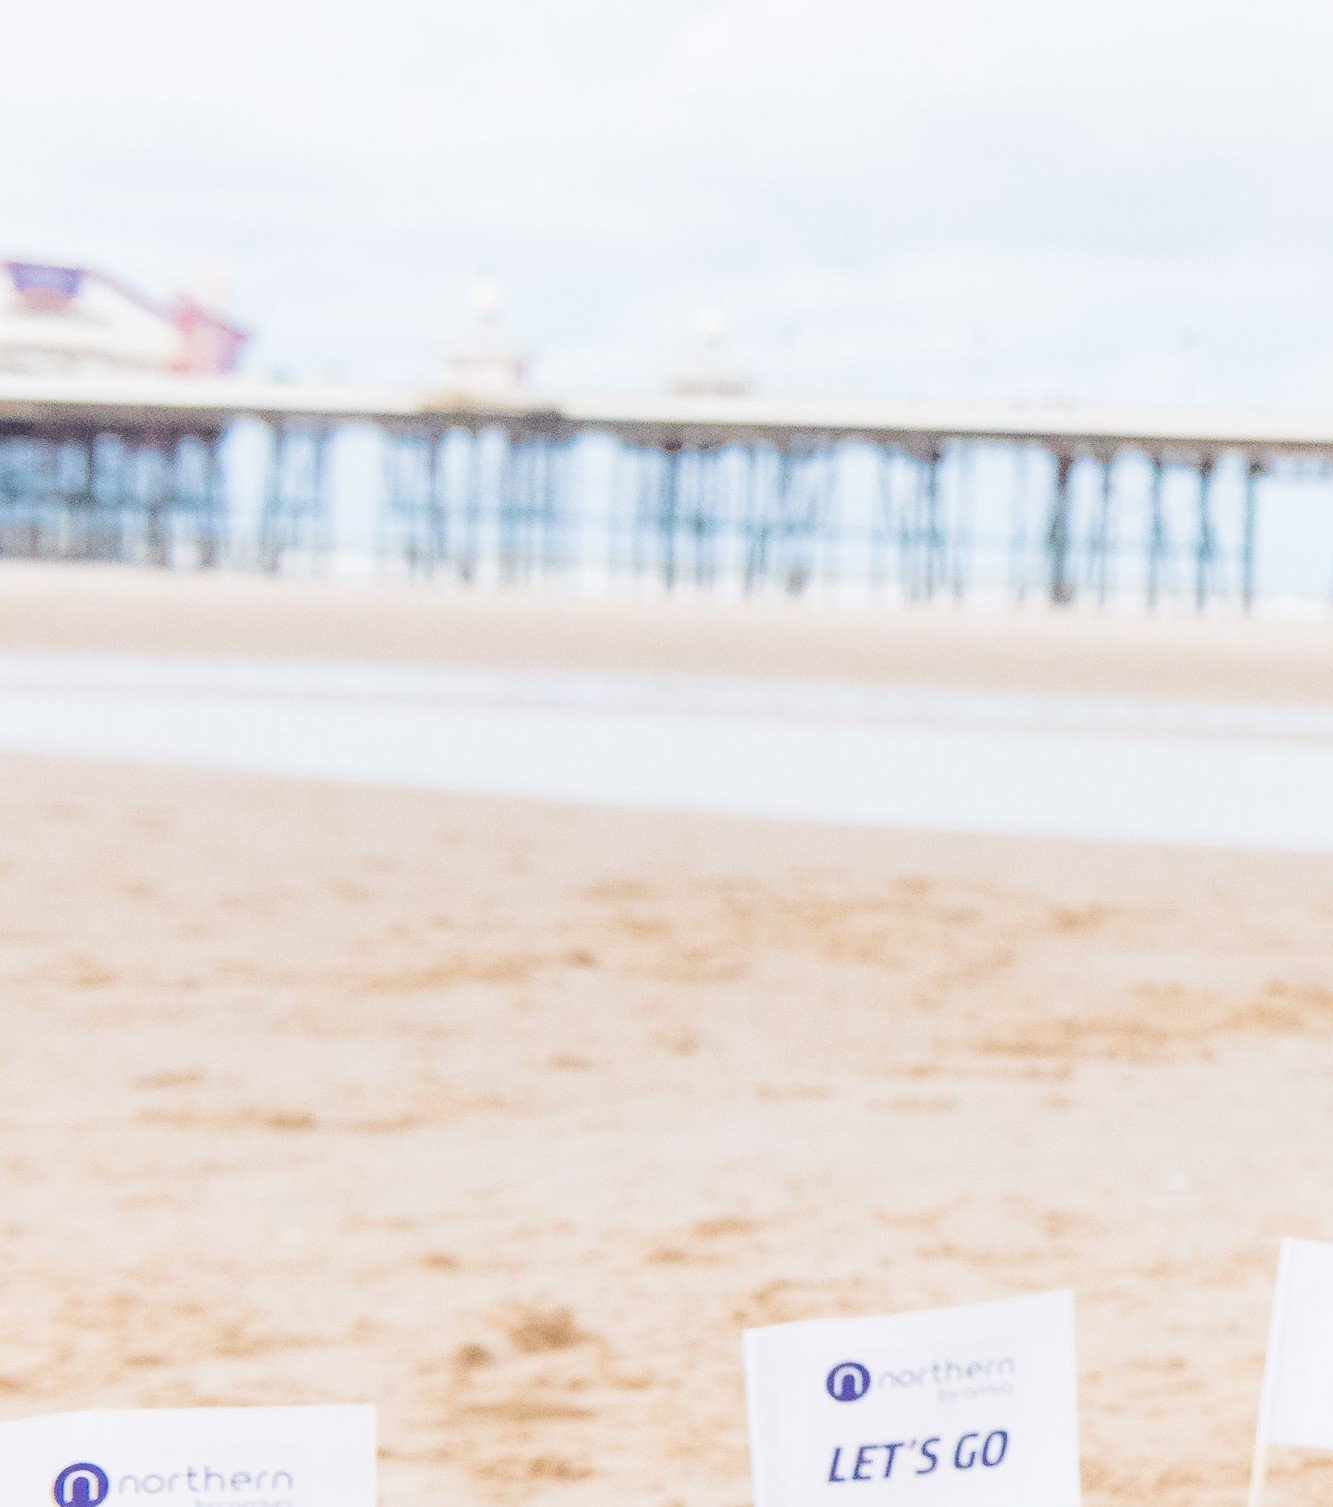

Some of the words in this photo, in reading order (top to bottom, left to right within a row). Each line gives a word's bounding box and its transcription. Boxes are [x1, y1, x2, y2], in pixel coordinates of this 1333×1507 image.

[877, 1357, 1016, 1389] northern
[827, 1437, 942, 1483] LET'S
[953, 1428, 1009, 1470] GO
[118, 1465, 294, 1494] northern
